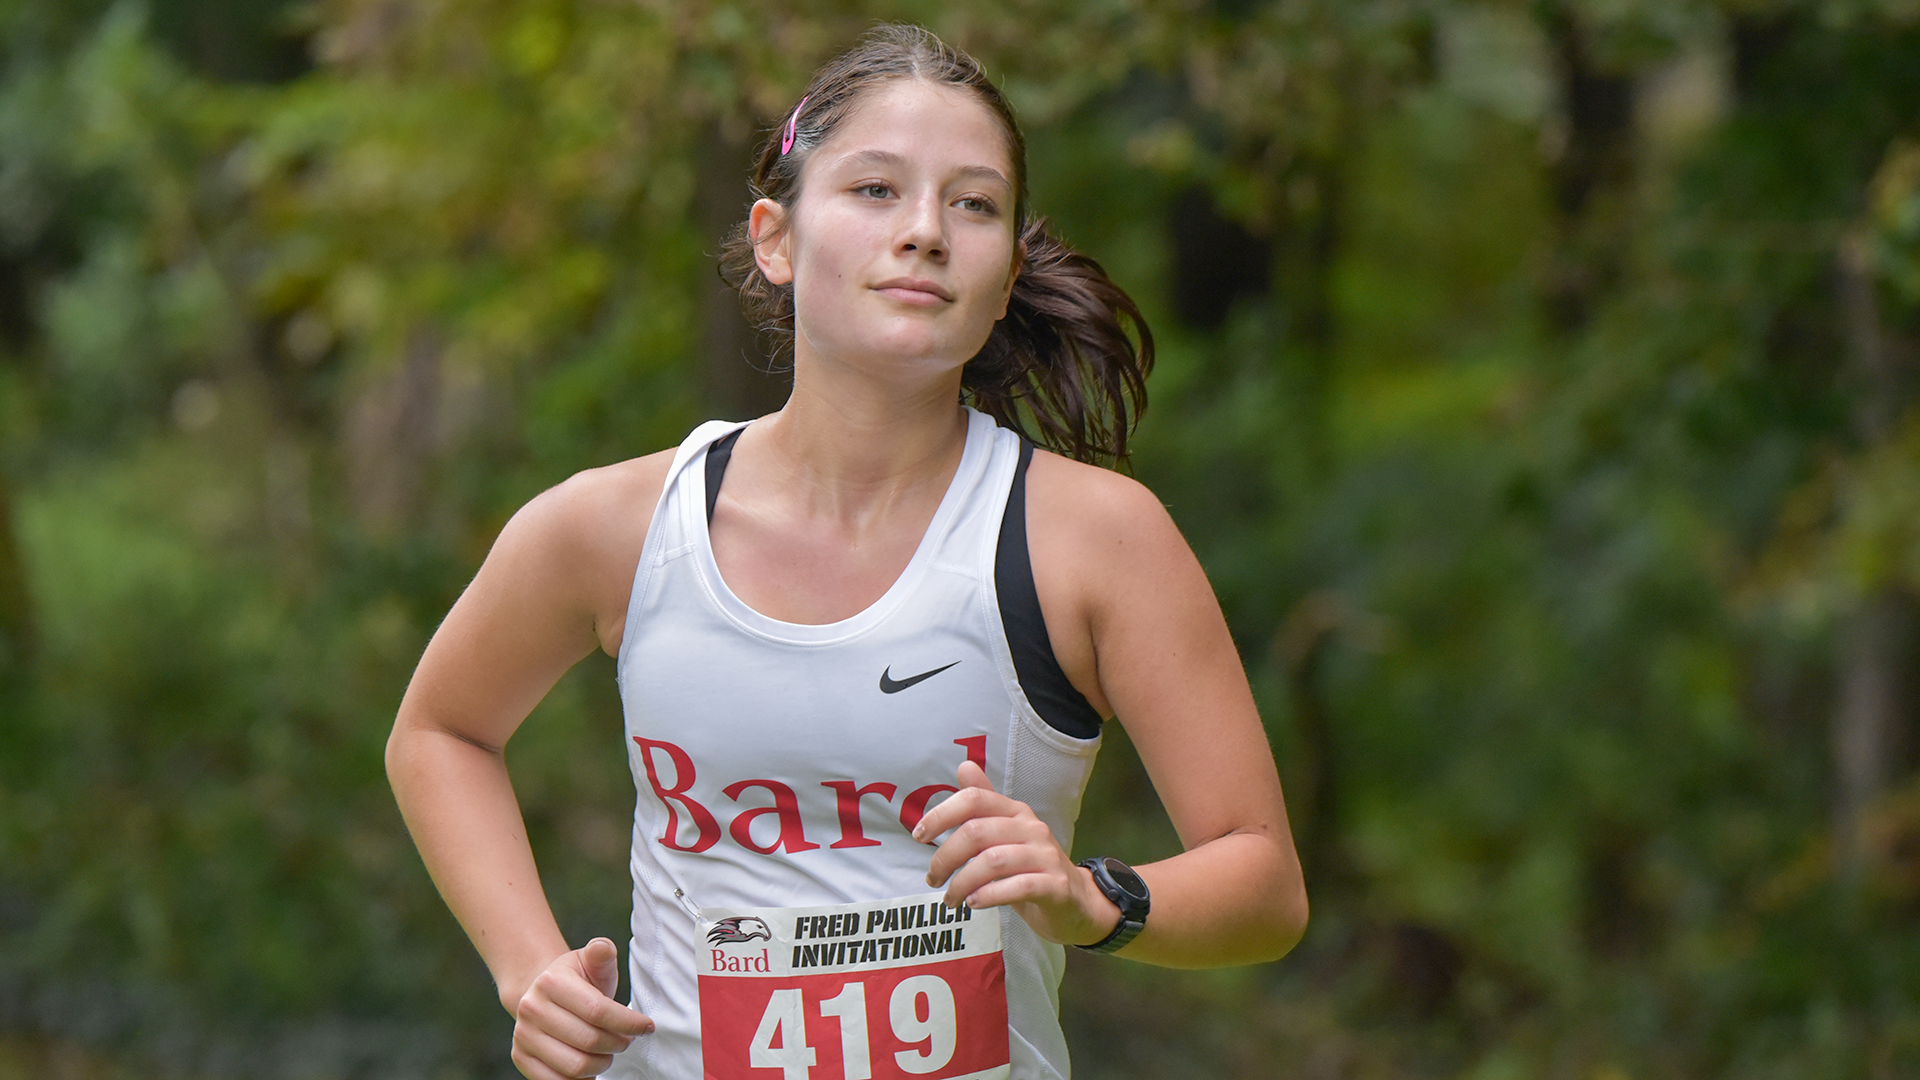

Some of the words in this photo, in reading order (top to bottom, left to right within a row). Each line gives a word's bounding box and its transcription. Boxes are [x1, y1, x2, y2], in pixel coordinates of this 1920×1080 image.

[795, 909, 860, 940] FRED
[866, 901, 972, 935] PAVLICH
[710, 948, 772, 973] Bard
[792, 928, 966, 968] INVITATIONAL
[749, 974, 958, 1080] 419
